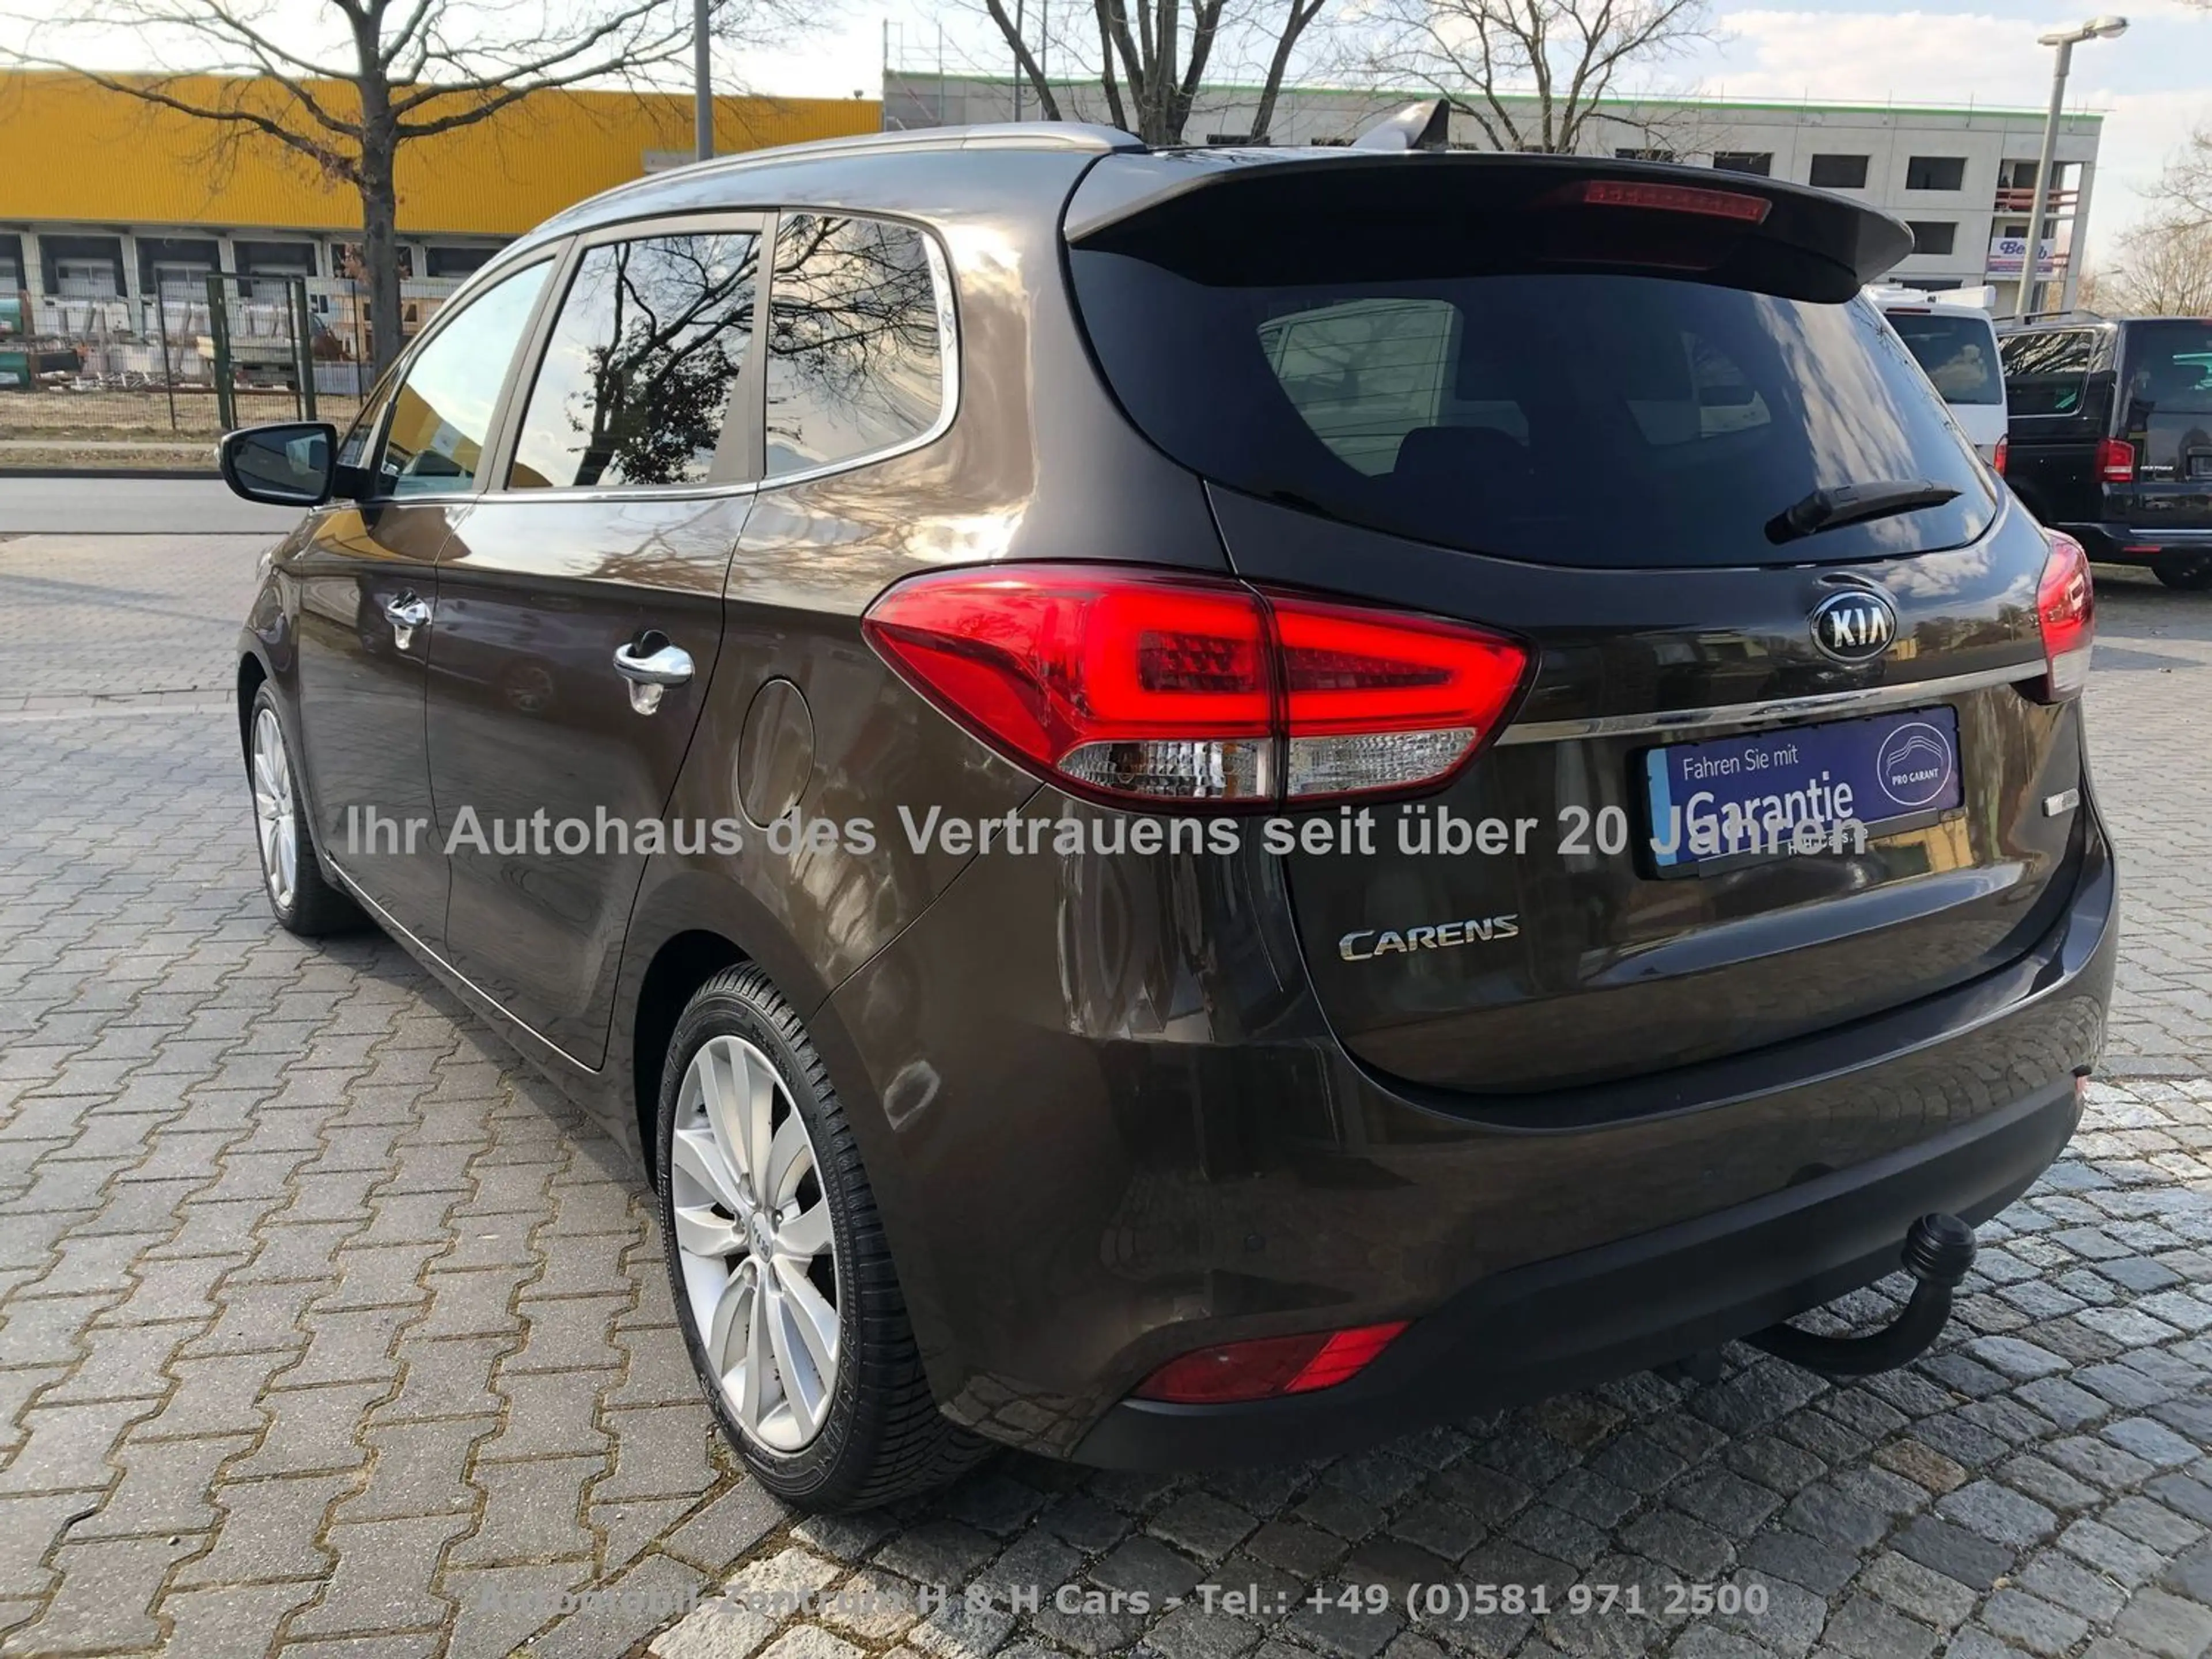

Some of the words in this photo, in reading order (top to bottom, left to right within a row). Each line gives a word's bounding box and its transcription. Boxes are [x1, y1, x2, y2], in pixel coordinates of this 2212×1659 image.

[1830, 607, 1887, 647] KIA
[1683, 756, 1740, 780] Fahren
[1744, 748, 1769, 771] Sie
[1773, 744, 1799, 767] mit
[1892, 774, 1907, 786] PRO
[1908, 767, 1940, 782] GARANT
[1686, 771, 1853, 844] Garantie
[1339, 914, 1519, 961] CARENS
